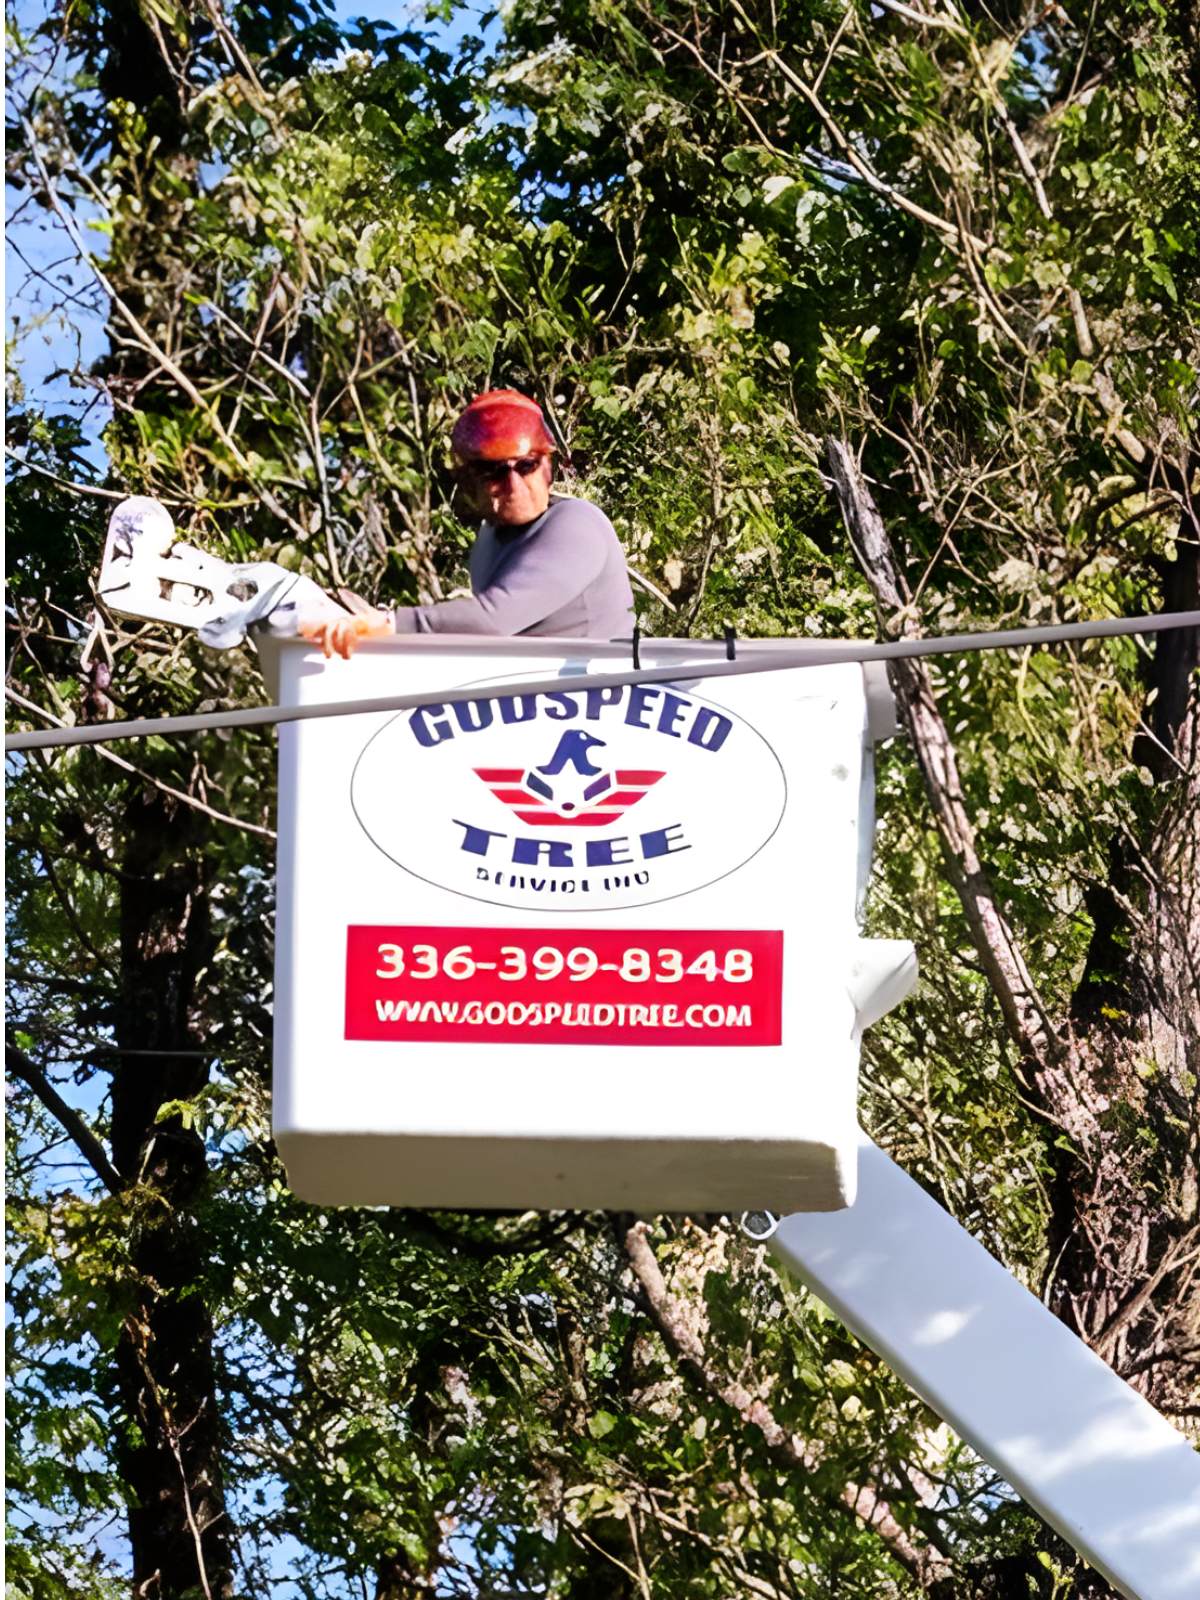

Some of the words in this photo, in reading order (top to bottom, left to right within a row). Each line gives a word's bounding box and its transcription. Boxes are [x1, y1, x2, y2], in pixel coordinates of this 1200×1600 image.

[408, 684, 734, 752] GODSPEED
[452, 818, 692, 867] TREE
[375, 943, 753, 983] 336-399-8348
